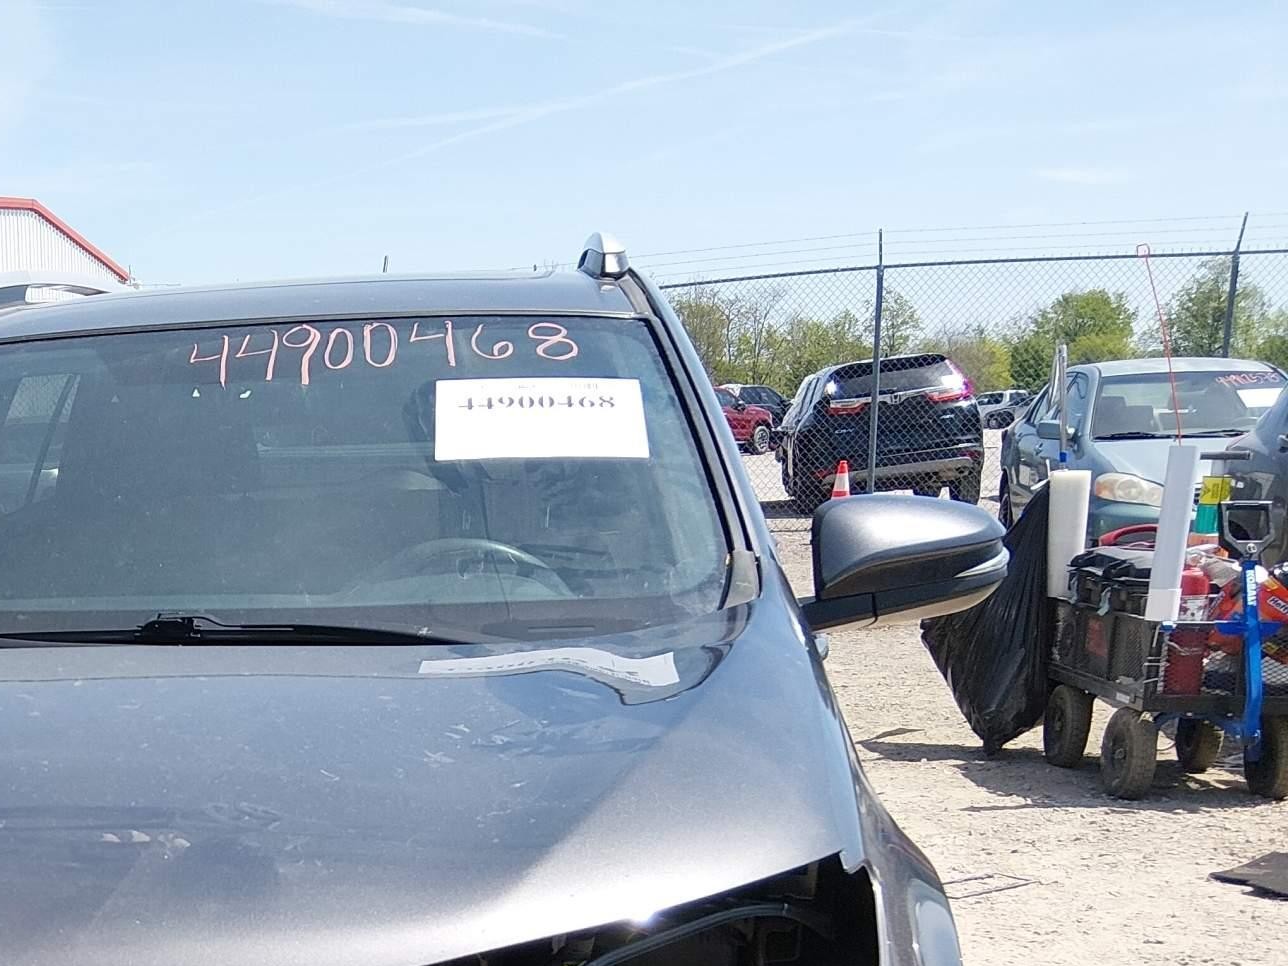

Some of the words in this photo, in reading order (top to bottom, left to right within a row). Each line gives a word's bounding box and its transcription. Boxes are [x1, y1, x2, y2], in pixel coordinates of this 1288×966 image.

[189, 320, 580, 391] 44900468
[458, 395, 616, 411] 44900468
[1245, 569, 1258, 607] KOBALT
